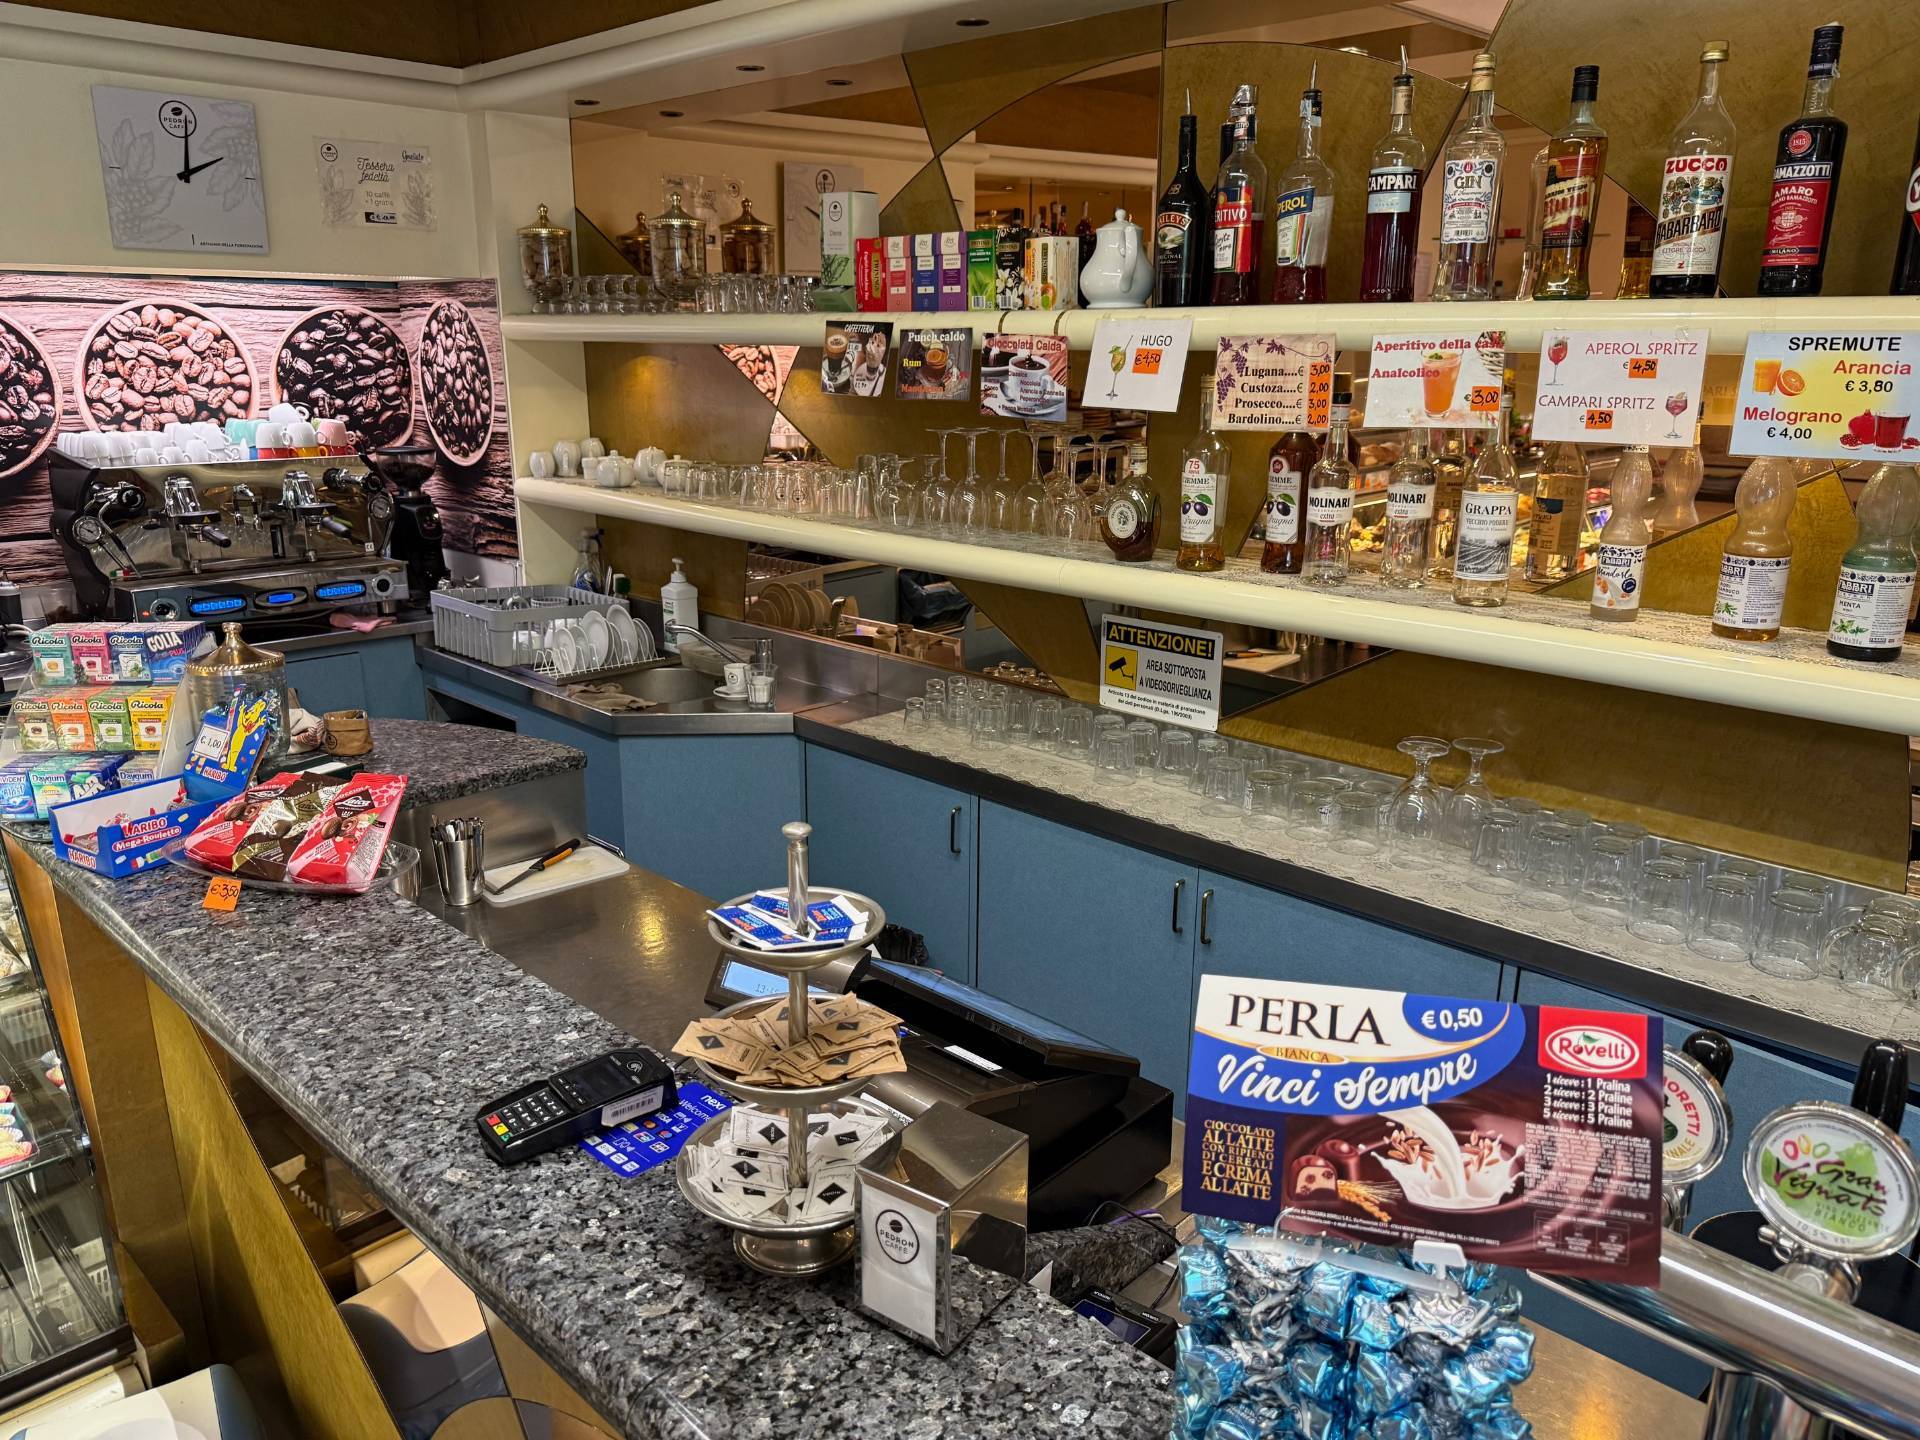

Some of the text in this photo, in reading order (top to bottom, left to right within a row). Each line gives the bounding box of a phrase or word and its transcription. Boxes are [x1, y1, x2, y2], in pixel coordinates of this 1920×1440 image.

[1453, 175, 1483, 190] GIN
[1775, 186, 1813, 198] AMARO
[1277, 195, 1307, 214] PEROL
[1159, 213, 1186, 226] AILEYS
[1215, 208, 1247, 223] RITIVO
[1657, 206, 1723, 242] RABARBARO
[908, 331, 966, 342] Punch caldo
[1140, 335, 1173, 347] HUGO
[1788, 336, 1902, 351] SPREMUTE
[988, 338, 1062, 351] Cioccolata Calda
[1374, 339, 1504, 353] Aperitivo della casa
[1585, 342, 1698, 356] APEROL SPRITZ
[903, 358, 922, 368] Rum
[1310, 363, 1330, 377] 3,00
[1622, 360, 1657, 374] € 4,50
[1833, 359, 1912, 375] Arancia
[1371, 367, 1440, 379] Analcolico
[1309, 382, 1329, 394] 2,00
[1845, 380, 1894, 395] € 3,80
[1308, 398, 1327, 411] 3,00
[1464, 389, 1499, 406] € 3,00
[1538, 394, 1655, 410] CAMPARI SPRITZ
[1307, 414, 1327, 426] 2,00
[1579, 413, 1613, 426] € 4,50
[1743, 406, 1842, 426] Melograno
[1767, 427, 1813, 441] € 4,00
[1188, 460, 1200, 470] 75
[1309, 497, 1350, 508] MOLINARI
[1465, 502, 1512, 516] GRAPPA
[1839, 600, 1861, 609] MENTA
[31, 636, 65, 646] Ricola
[72, 635, 103, 645] Ricola
[110, 635, 143, 645] Ricola
[147, 632, 182, 651] GOLIA
[1108, 624, 1212, 657] ATTENZIONE!
[1146, 659, 1206, 681] AREA SOTTOPOSTA
[1139, 678, 1212, 701] A VIDEOSORVEGLIANZA
[14, 701, 49, 710] Ricola
[51, 701, 84, 711] Ricola
[89, 701, 123, 710] Ricola
[130, 700, 164, 709] Ricola
[32, 774, 65, 785] Daygum
[120, 772, 154, 781] Daygum
[203, 767, 227, 782] HARIBO
[68, 849, 97, 869] HARIBO
[219, 883, 239, 902] 3,50
[1225, 993, 1392, 1046] PERLA
[1421, 1007, 1483, 1031] € 0,50
[1276, 1046, 1330, 1063] BIANCA
[1559, 1037, 1626, 1060] Rovelli
[1217, 1052, 1478, 1110] Vinci Sempre
[1545, 1073, 1552, 1084] 1
[1587, 1078, 1592, 1089] 1
[1596, 1078, 1631, 1093] Pralina
[700, 1094, 727, 1111] nexi
[1544, 1085, 1552, 1095] 2
[1587, 1090, 1596, 1100] 2
[1598, 1090, 1633, 1105] Praline
[1544, 1097, 1552, 1107] 3
[1587, 1101, 1595, 1112] 3
[1598, 1102, 1633, 1117] Praline
[655, 1111, 673, 1124] VISA
[1543, 1108, 1552, 1119] 5
[1587, 1114, 1595, 1125] 5
[1598, 1114, 1633, 1129] Praline
[1204, 1119, 1275, 1138] CIOCCOLATO
[1202, 1129, 1275, 1152] AL LATTE
[1202, 1142, 1274, 1160] CON RIPIENO
[1202, 1151, 1273, 1170] DI CEREALI
[1202, 1160, 1272, 1186] E CREMA
[1816, 1160, 1888, 1195] Gran
[1200, 1176, 1271, 1200] AL LATTE
[1814, 1208, 1866, 1232] BIANCO
[880, 1228, 915, 1249] PEDRON
